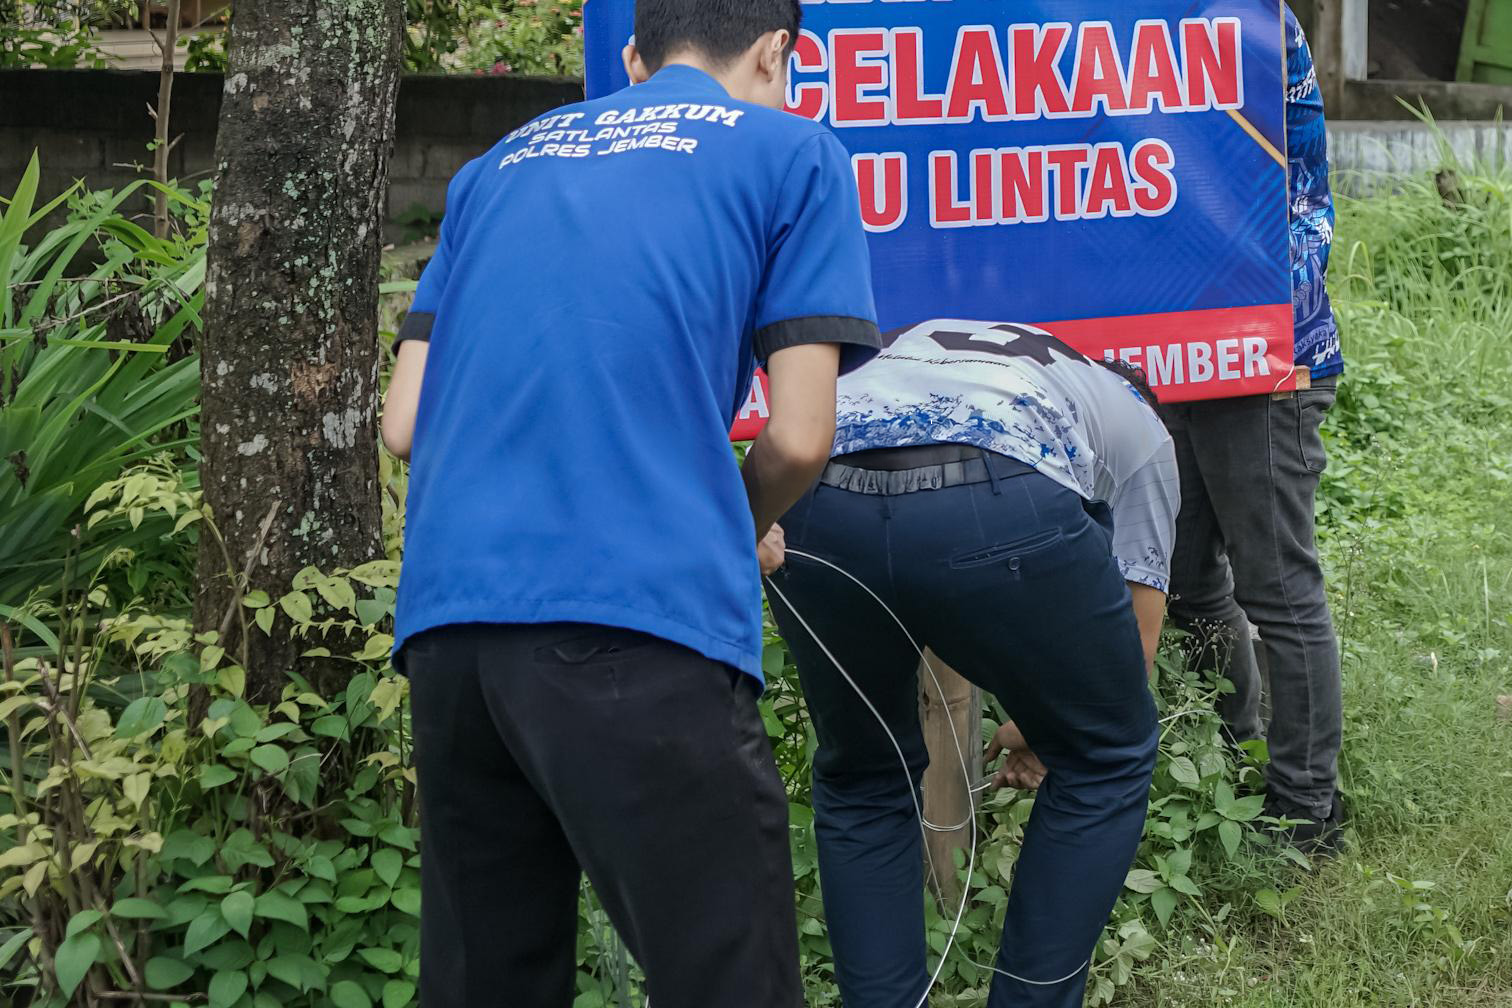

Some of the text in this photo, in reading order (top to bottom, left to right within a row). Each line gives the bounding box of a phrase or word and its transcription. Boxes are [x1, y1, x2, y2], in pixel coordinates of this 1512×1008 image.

[504, 103, 744, 144] UNIT GAKKUM
[528, 121, 678, 146] SATLANTAS
[498, 135, 699, 170] POLRES JEMBER
[932, 141, 1174, 225] LINTAS
